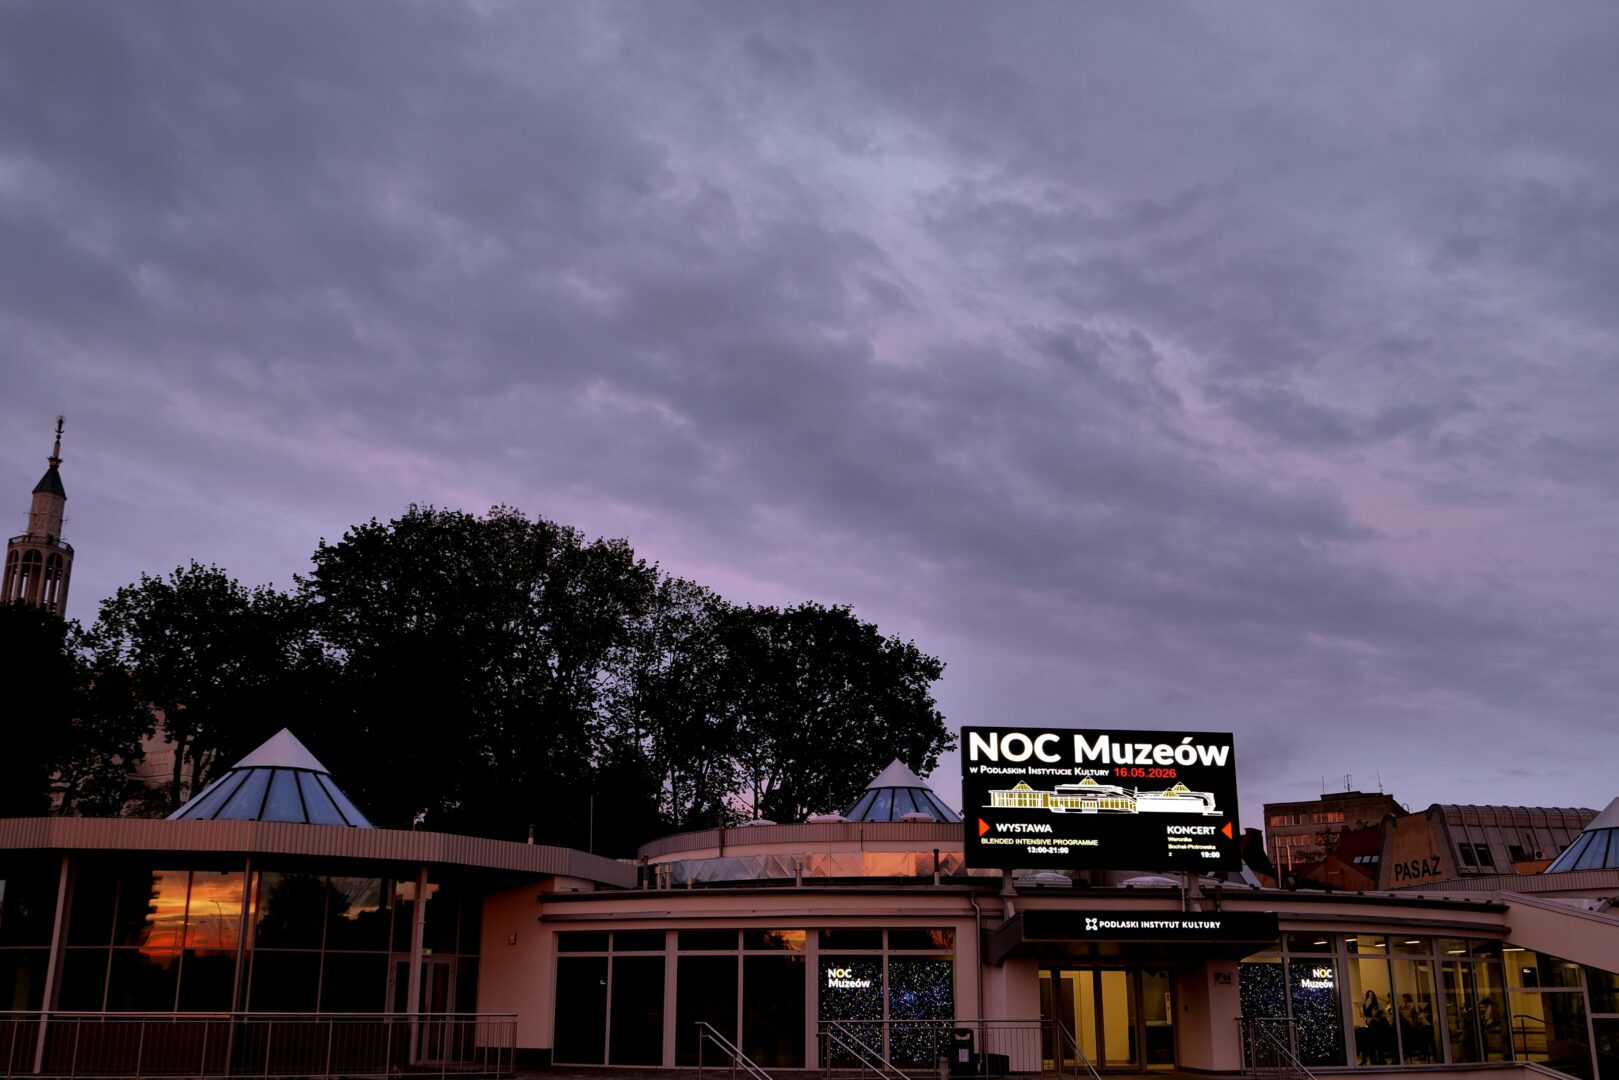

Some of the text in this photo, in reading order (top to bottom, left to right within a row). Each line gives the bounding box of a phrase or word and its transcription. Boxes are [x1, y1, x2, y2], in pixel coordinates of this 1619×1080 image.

[969, 731, 1230, 767] NOC Muzeów
[1114, 767, 1177, 779] 16.05.2026
[995, 823, 1053, 833] WYSTAWA
[1166, 825, 1216, 835] KONCERT
[981, 837, 1099, 847] BLENDED INTENSIVE PROGRAMME
[1027, 846, 1070, 854] 13:00-21:00
[1200, 851, 1221, 859] 19:00
[1099, 920, 1221, 929] PODLASKI INSTYTUT KULTURY
[828, 978, 871, 989] Muzeów
